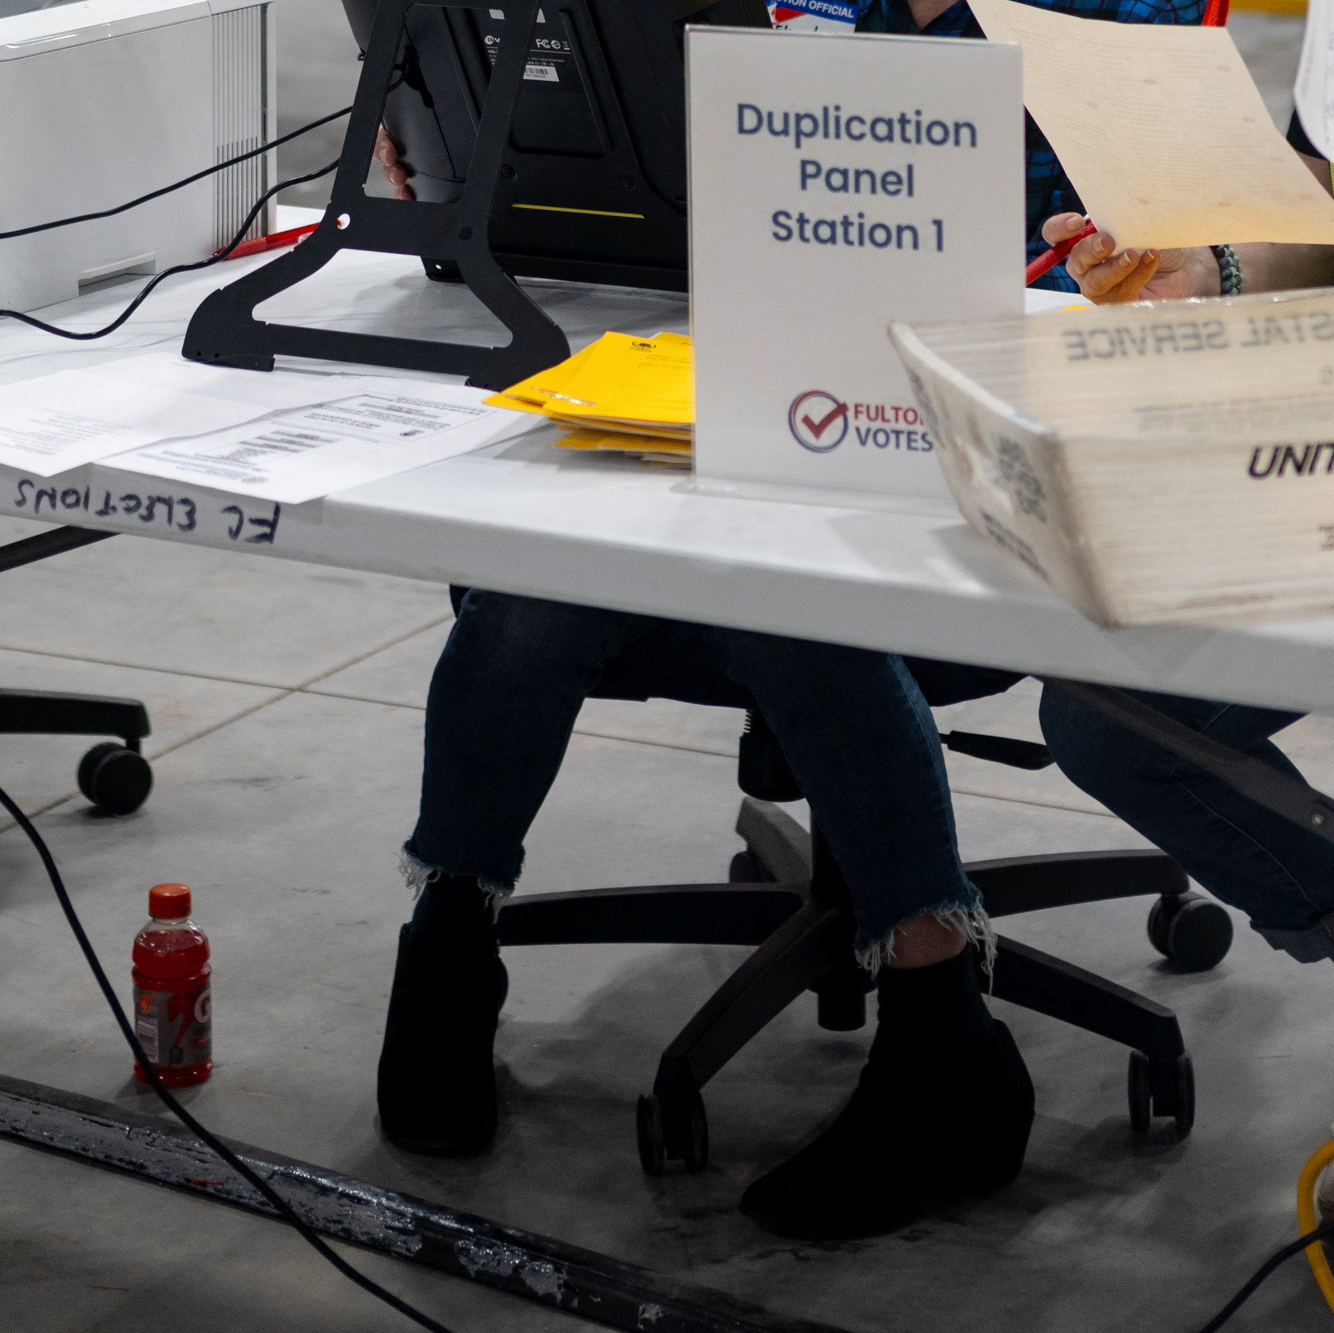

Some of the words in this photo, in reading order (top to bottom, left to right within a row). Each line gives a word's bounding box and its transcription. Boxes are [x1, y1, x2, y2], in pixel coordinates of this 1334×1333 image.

[809, 0, 854, 18] OFFICIAL
[737, 103, 978, 150] Duplication
[800, 159, 914, 198] Panel
[771, 209, 919, 251] Station
[932, 219, 944, 252] 1
[854, 403, 923, 426] FULTO
[855, 426, 934, 453] VOTES
[15, 478, 198, 533] ELECTIONS
[219, 502, 282, 545] FC
